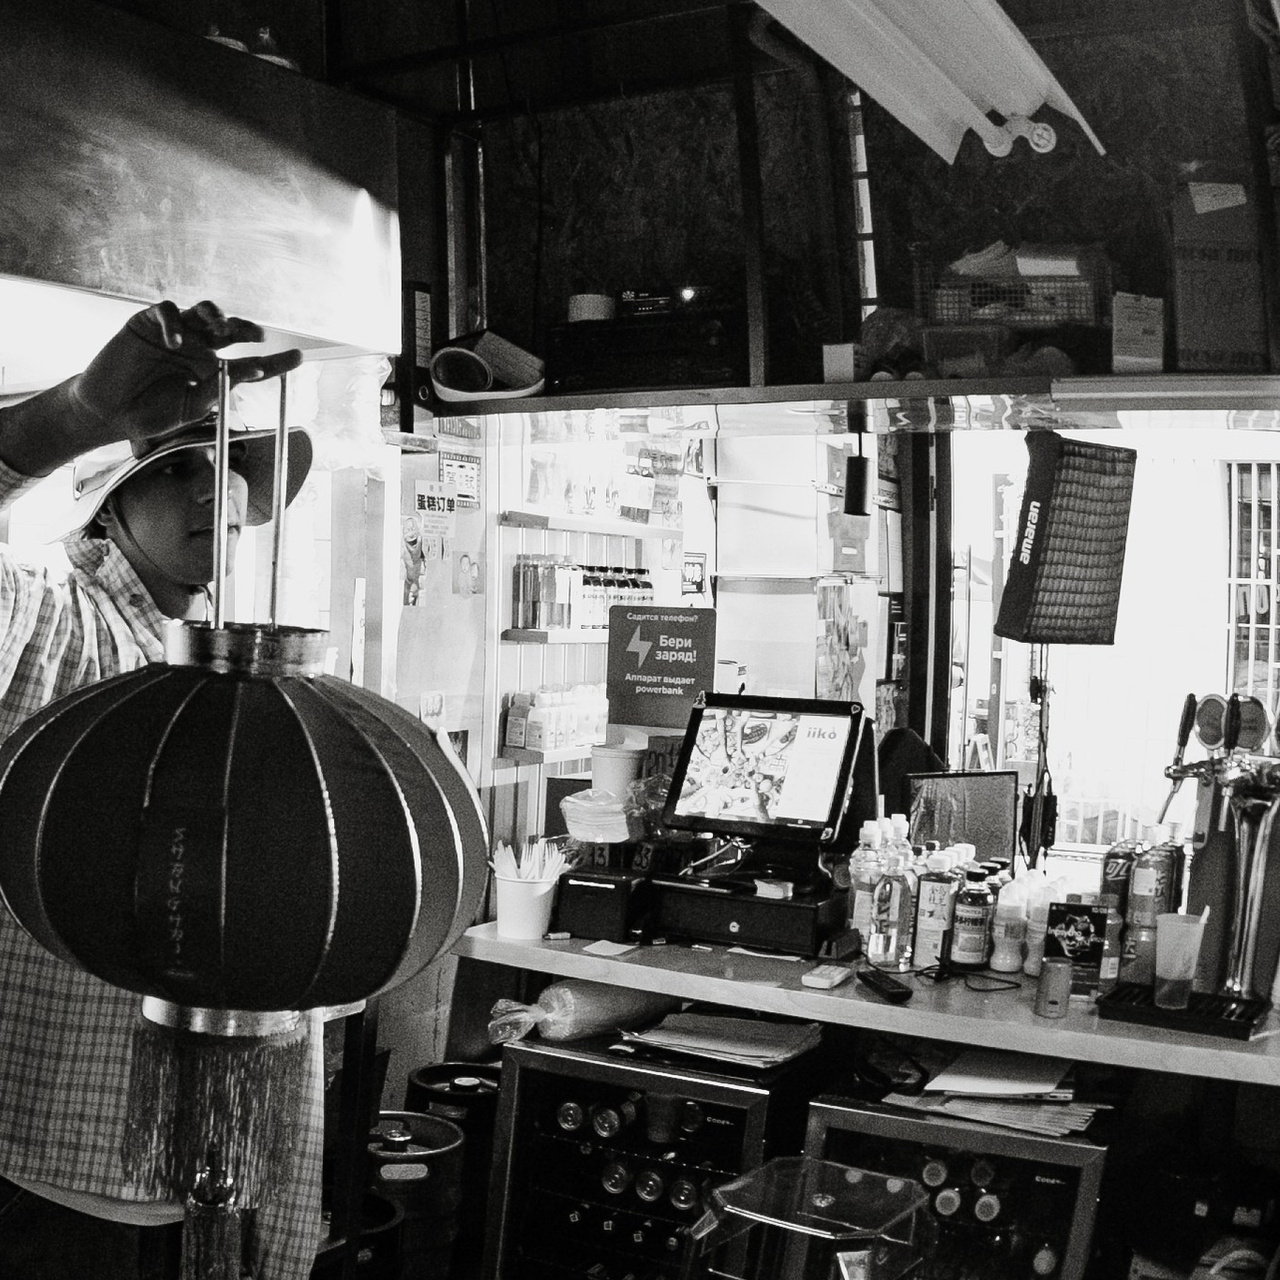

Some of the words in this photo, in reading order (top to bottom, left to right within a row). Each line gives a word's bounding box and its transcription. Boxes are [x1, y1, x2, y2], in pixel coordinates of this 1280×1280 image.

[417, 494, 455, 513] 蛋糕订单
[1020, 500, 1040, 565] amaran
[626, 612, 659, 621] Садится
[660, 614, 698, 623] телефон?
[659, 634, 692, 650] Бери
[655, 650, 697, 663] заряд!
[625, 673, 662, 684] Аппарат
[663, 677, 696, 685] выдает
[635, 685, 684, 695] powerbank
